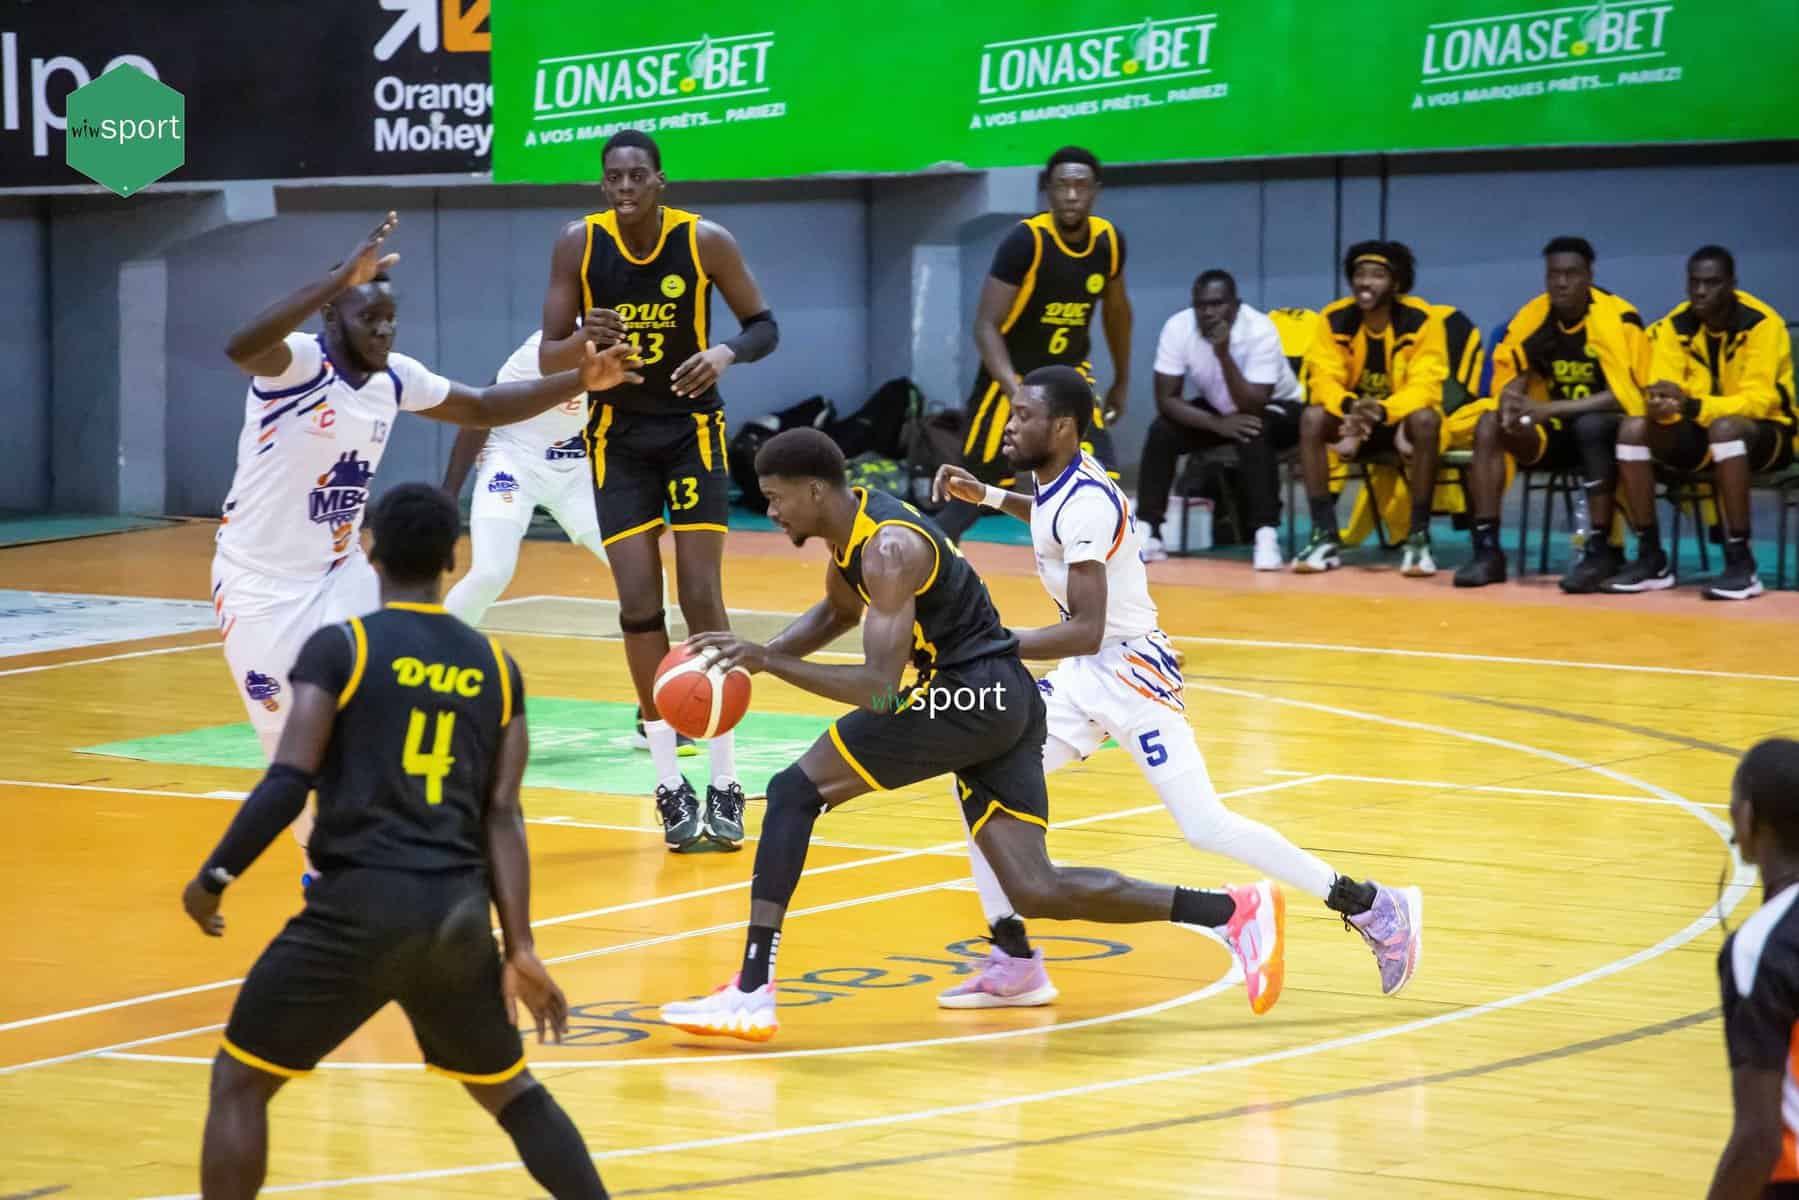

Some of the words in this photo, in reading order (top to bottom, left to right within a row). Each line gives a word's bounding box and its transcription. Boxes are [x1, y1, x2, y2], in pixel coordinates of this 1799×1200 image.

[2, 32, 160, 157] lp
[1427, 91, 1460, 107] VOS
[985, 110, 1018, 127] VOS
[1020, 100, 1099, 122] MARQUES
[374, 117, 495, 157] Money
[540, 128, 573, 145] VOS
[614, 303, 677, 321] DUC
[1045, 302, 1091, 318] DUC
[626, 331, 665, 365] 13
[1048, 328, 1070, 354] 6
[667, 477, 699, 510] 13
[391, 656, 484, 698] DUC
[402, 706, 456, 805] 4
[1139, 729, 1168, 767] 5
